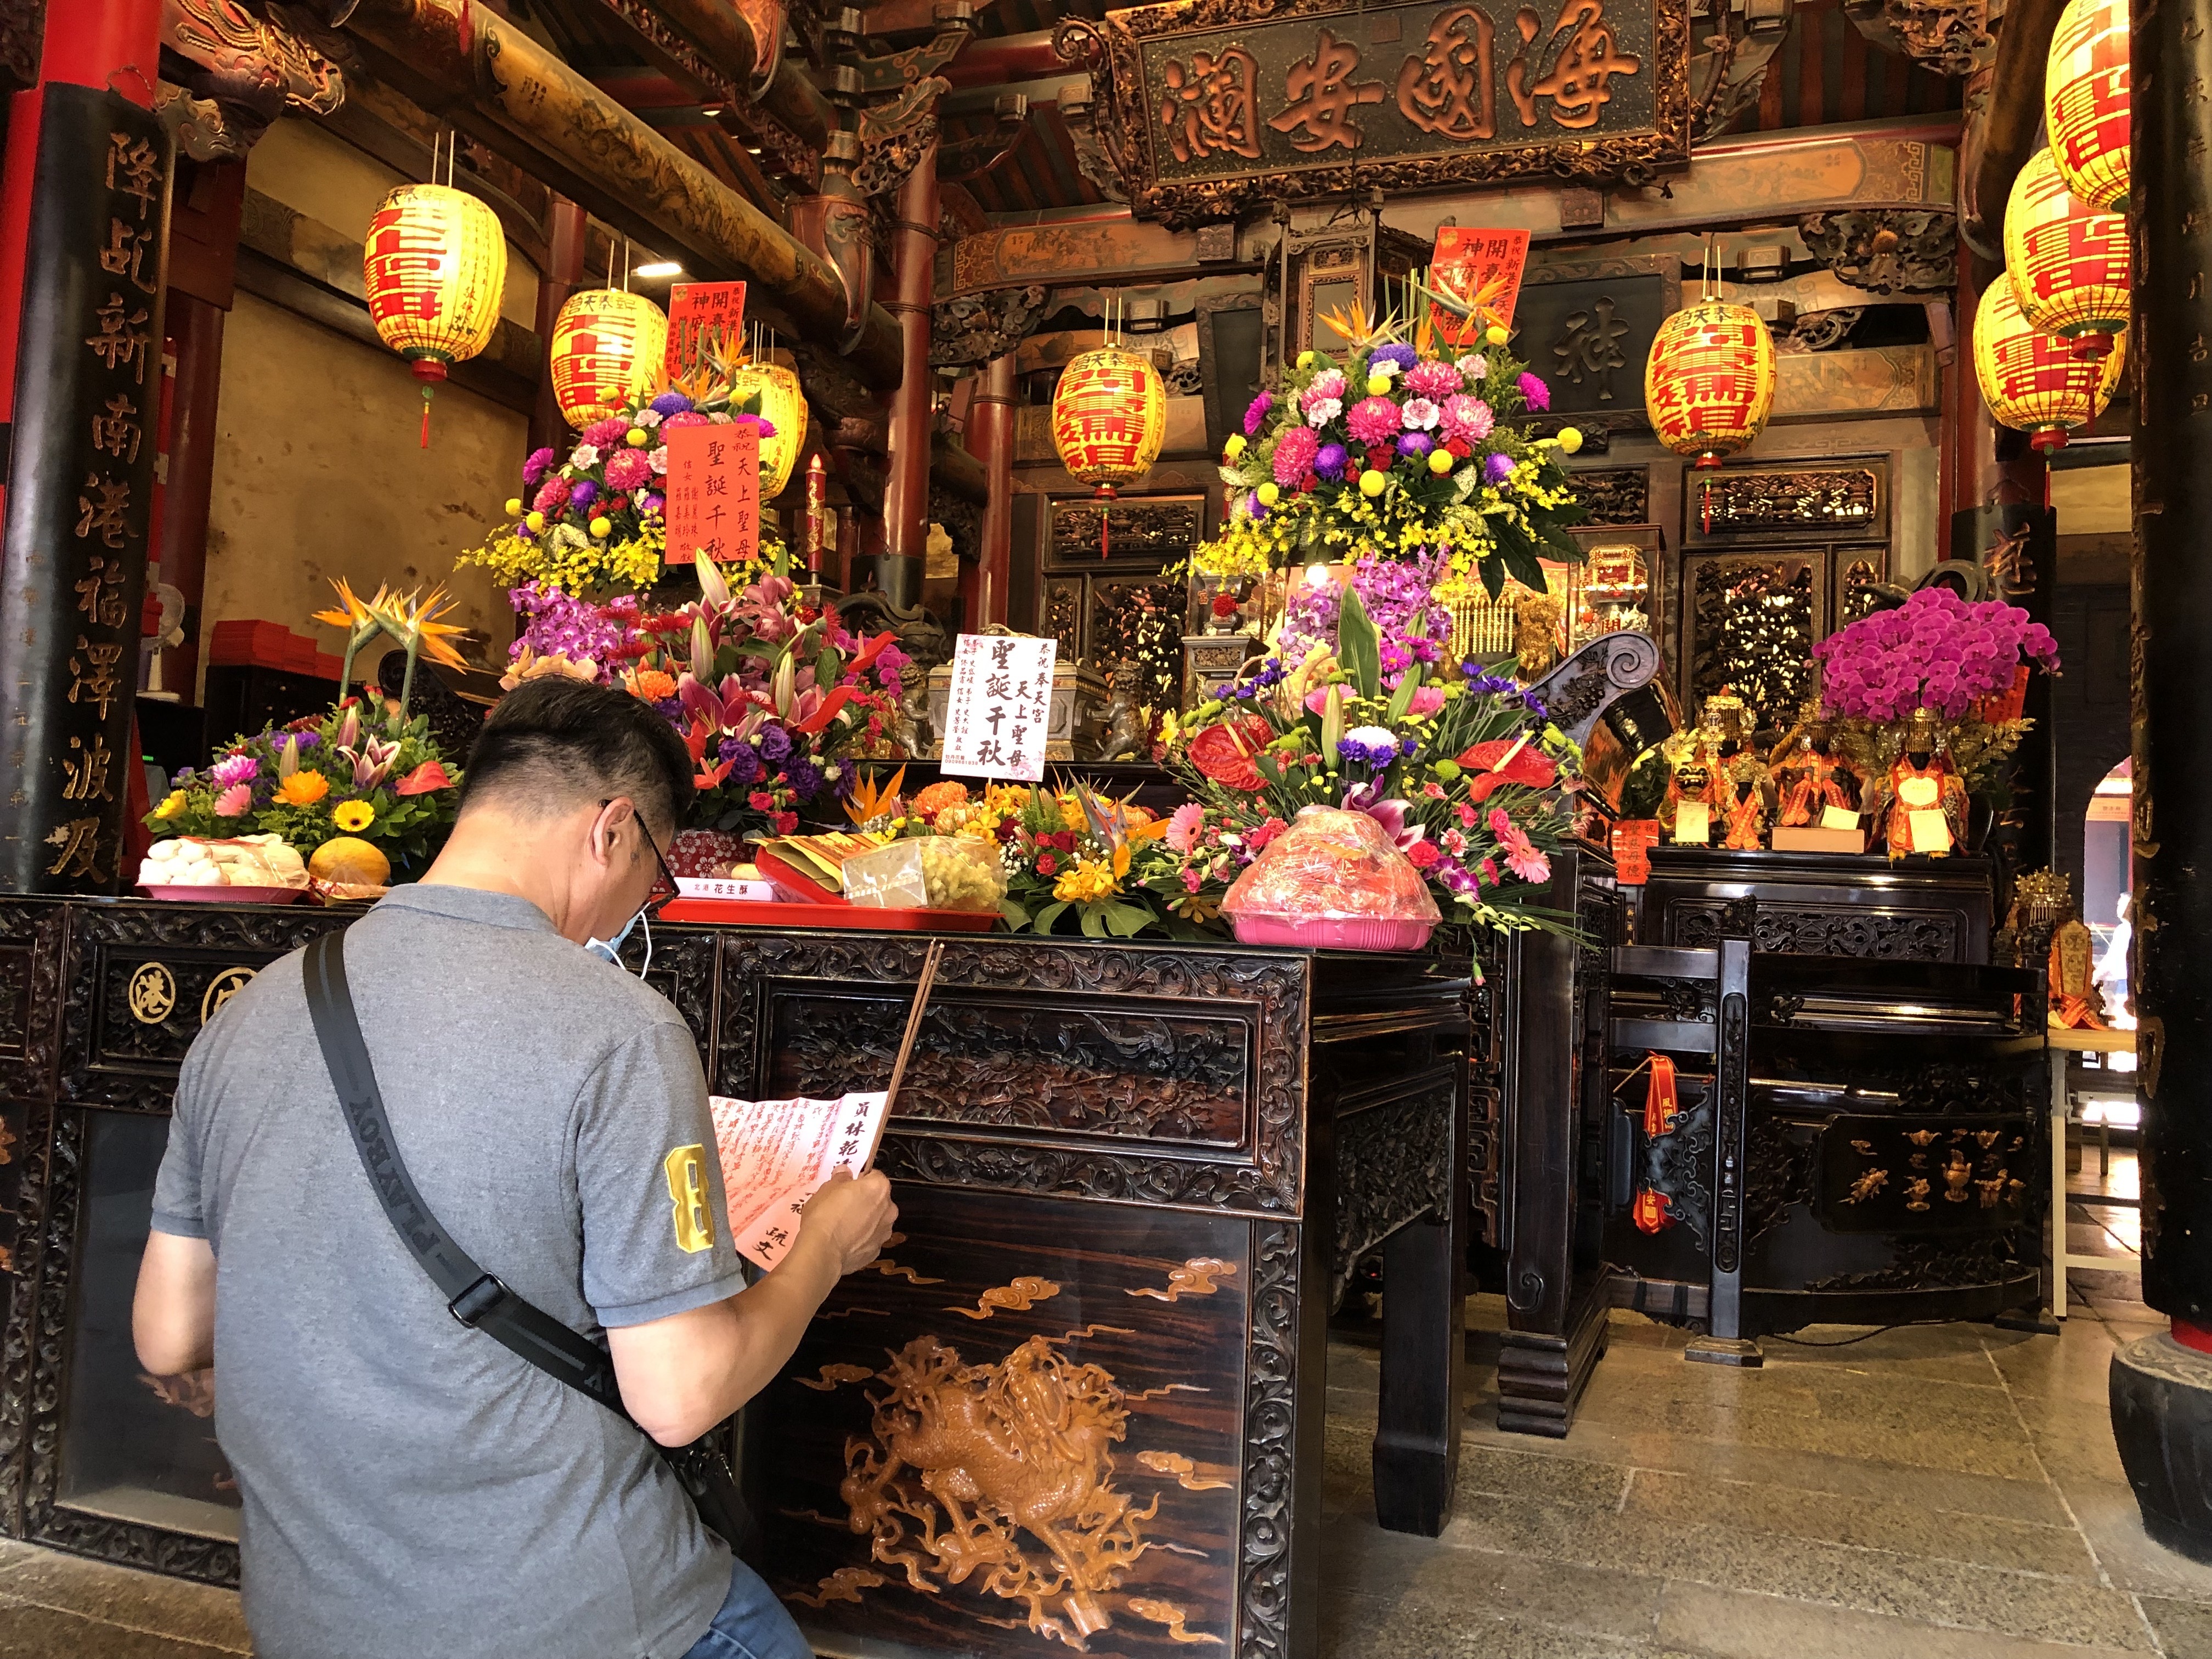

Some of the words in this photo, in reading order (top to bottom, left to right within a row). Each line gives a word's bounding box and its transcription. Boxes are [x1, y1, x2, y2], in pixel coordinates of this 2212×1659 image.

[704, 441, 729, 561] 聖誕千秋
[977, 639, 1016, 766] 聖誕千秋
[1006, 680, 1032, 768] 天上聖母
[1032, 642, 1051, 724] 恭祝奉天宮
[714, 883, 748, 895] 花生酥
[834, 1101, 870, 1168] 員林乾
